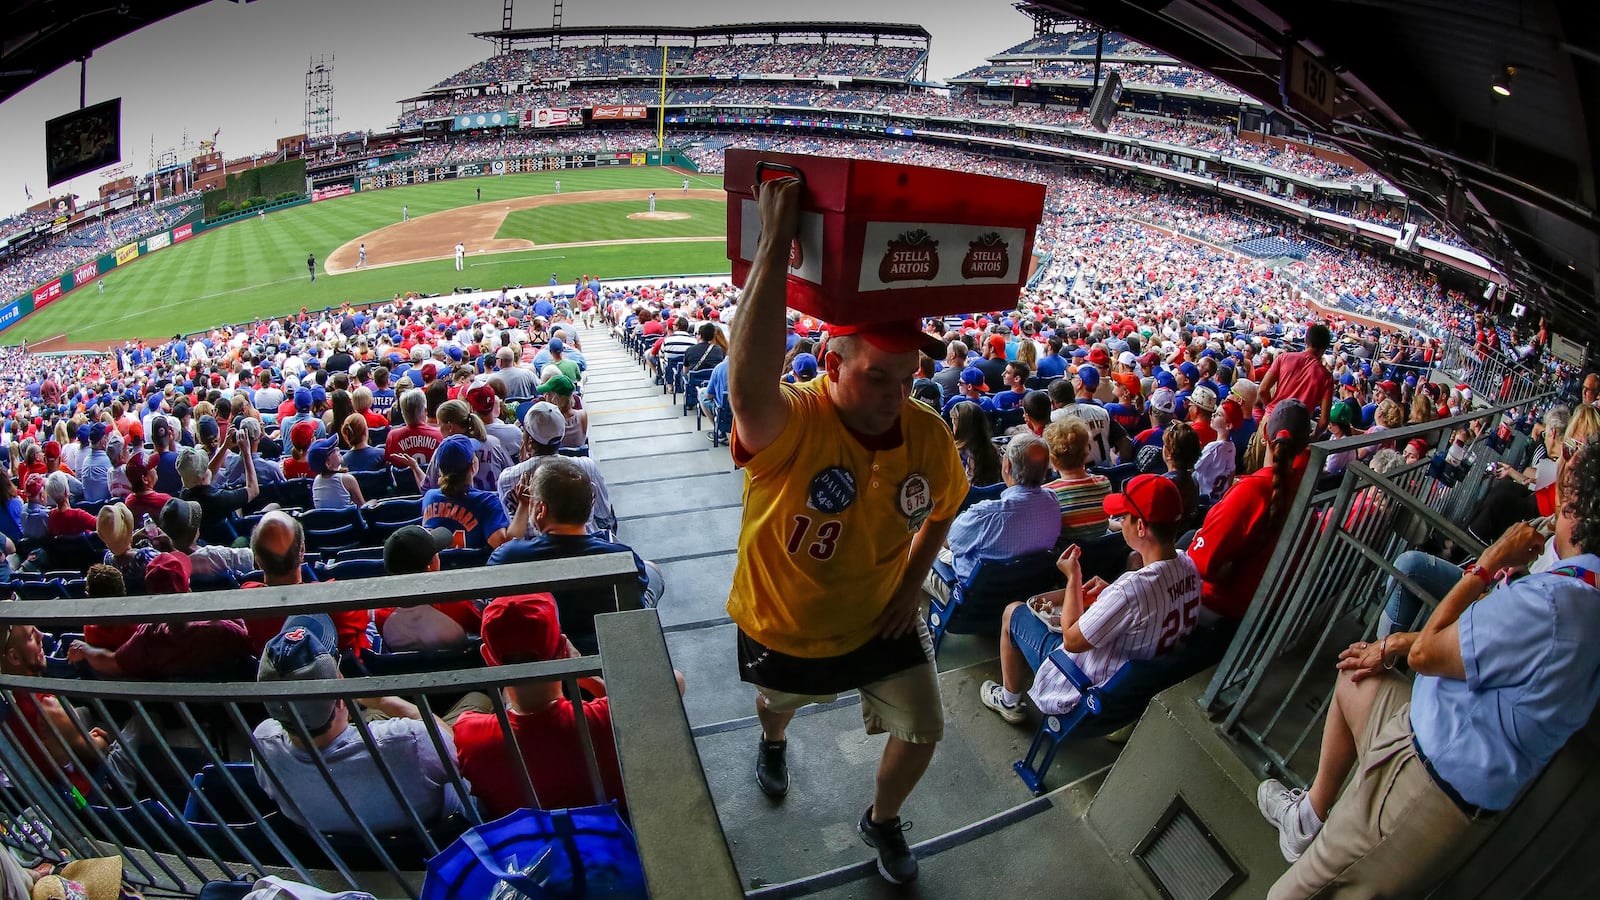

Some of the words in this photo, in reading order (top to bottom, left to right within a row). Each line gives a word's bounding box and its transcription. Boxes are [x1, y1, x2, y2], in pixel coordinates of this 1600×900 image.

[1303, 60, 1327, 105] 130
[893, 251, 930, 262] STELLA
[973, 251, 1002, 261] STELLA
[75, 264, 97, 284] xfinity
[890, 262, 929, 274] ARTOIS
[970, 262, 1001, 271] ARTOIS
[398, 435, 437, 451] VICTORINO
[786, 514, 843, 561] 13
[1193, 536, 1205, 551] P
[1167, 574, 1197, 603] THOME
[1157, 596, 1200, 656] 25
